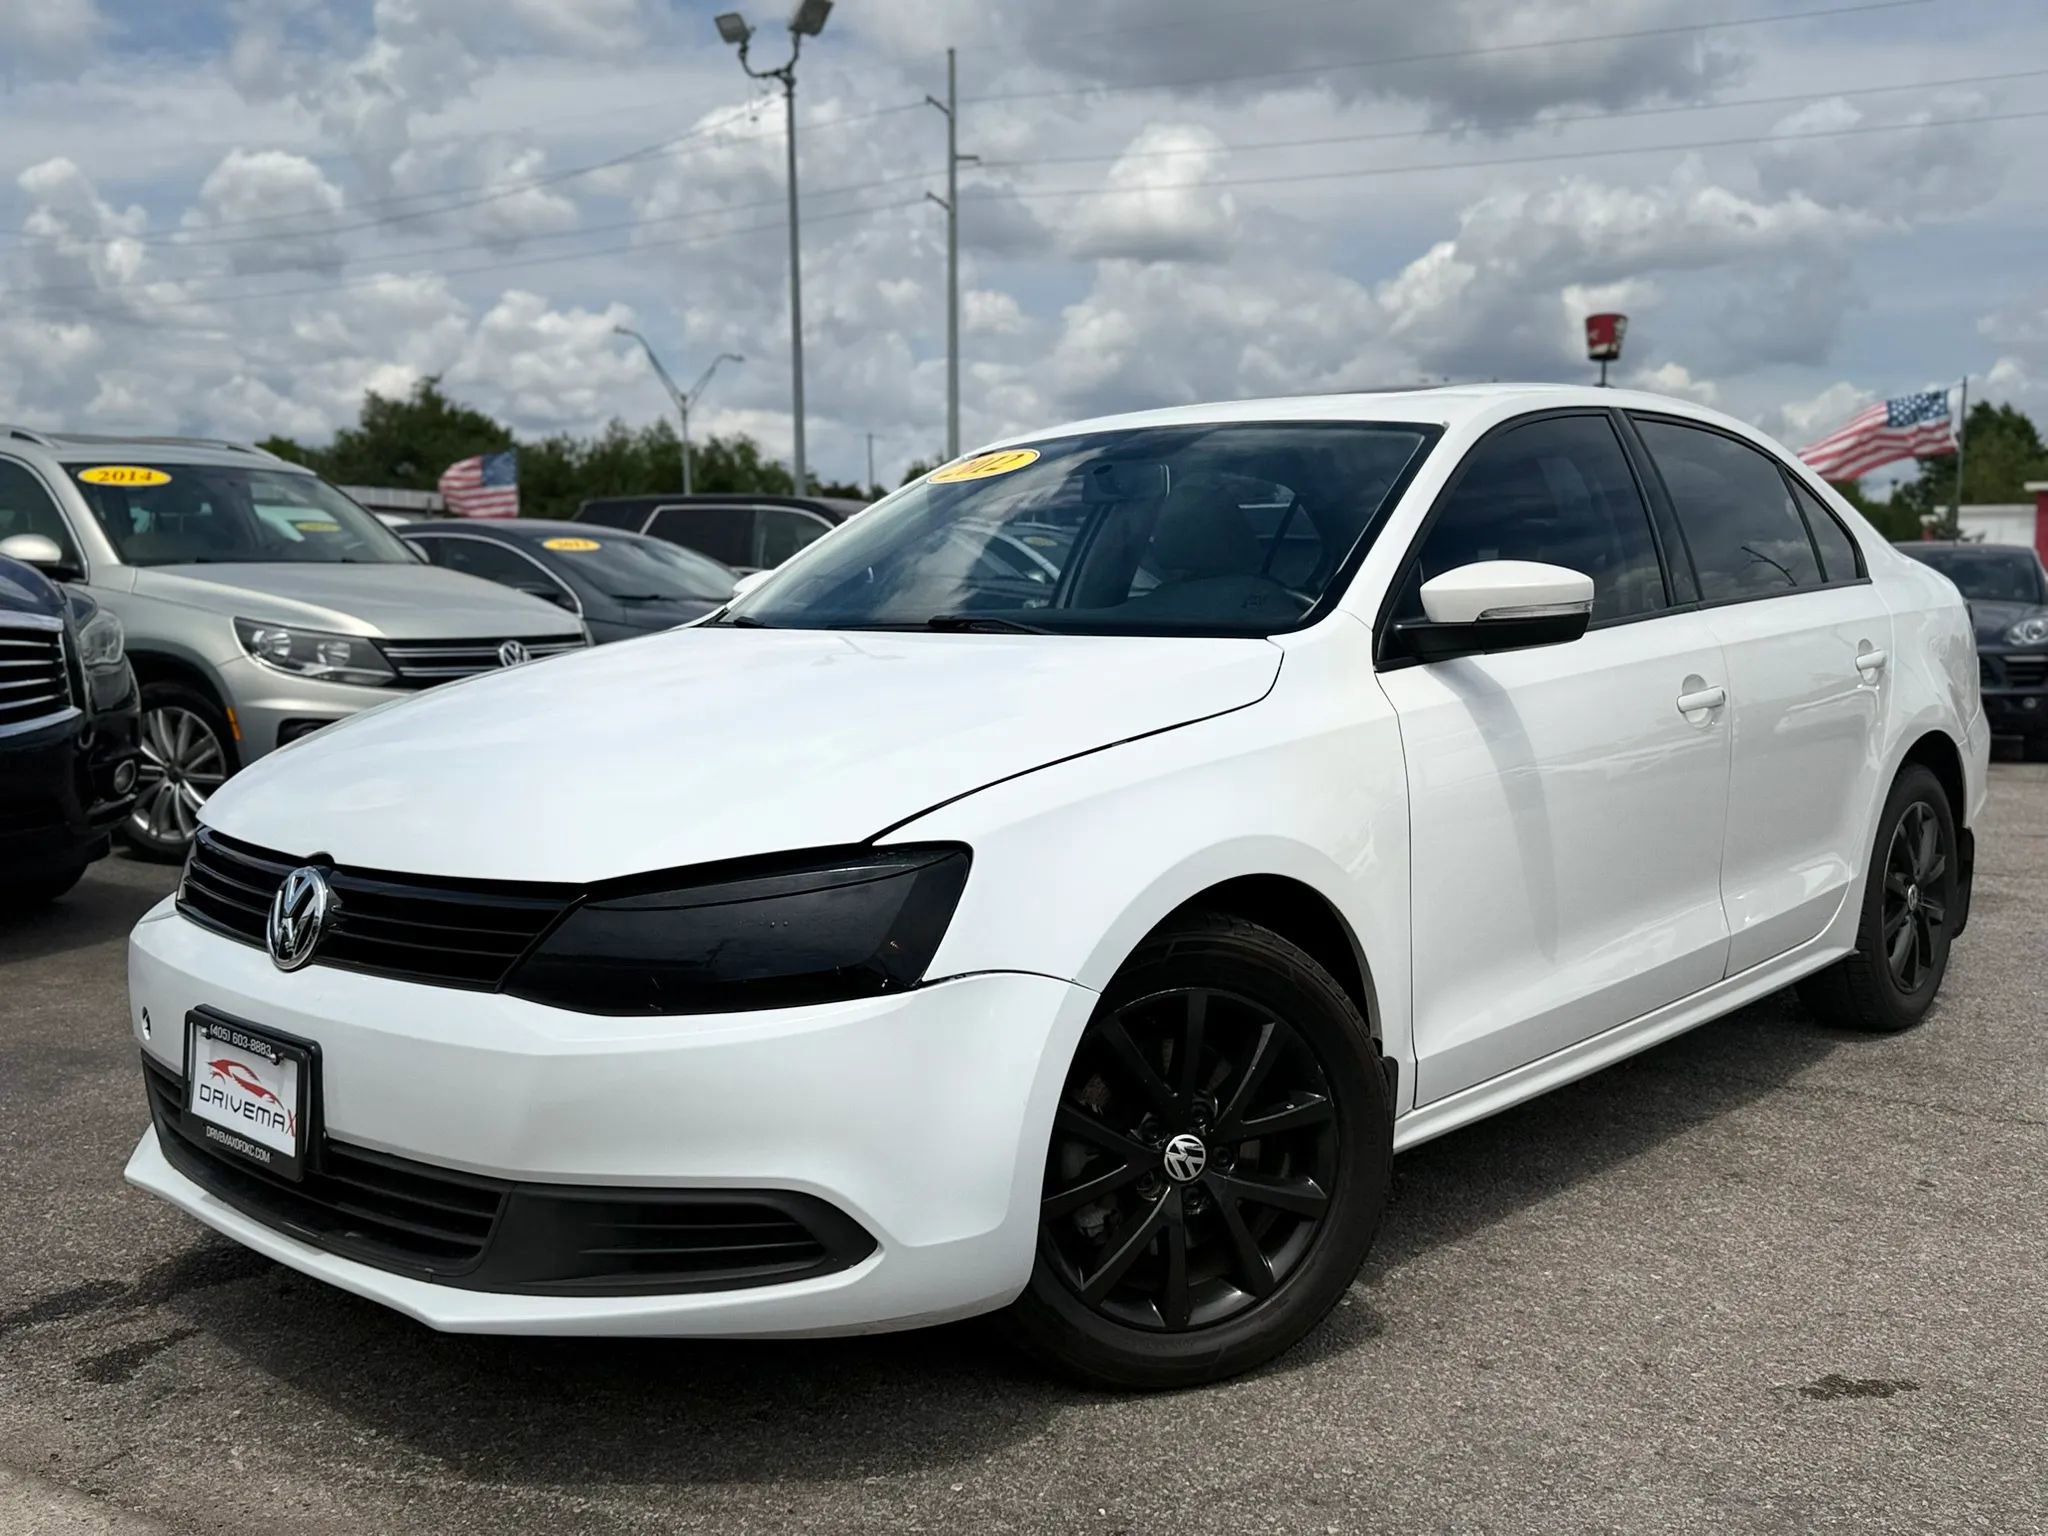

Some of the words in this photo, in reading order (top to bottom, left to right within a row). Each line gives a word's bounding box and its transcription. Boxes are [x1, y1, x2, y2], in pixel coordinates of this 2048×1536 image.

[98, 469, 153, 482] 2014
[210, 1024, 231, 1042] (405)
[232, 1032, 272, 1057] 603-8883
[200, 1083, 298, 1138] DRIVEMAX
